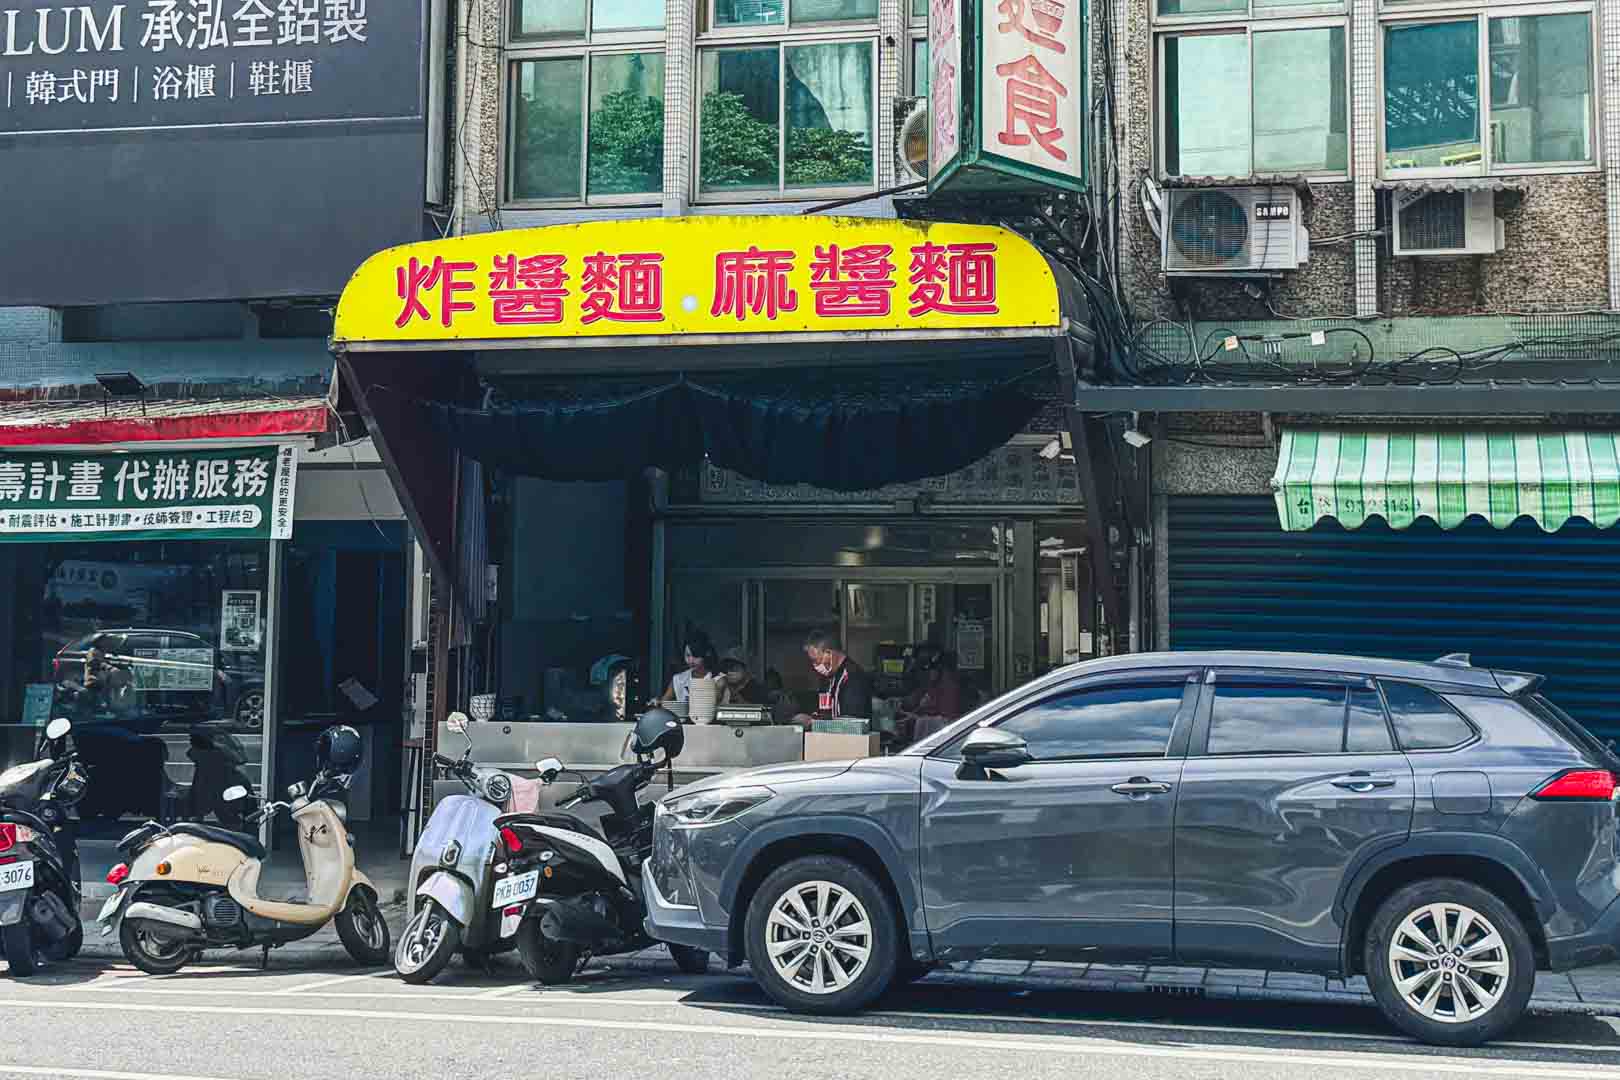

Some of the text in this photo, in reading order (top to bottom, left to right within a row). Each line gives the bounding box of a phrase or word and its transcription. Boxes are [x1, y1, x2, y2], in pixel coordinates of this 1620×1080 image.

[2, 5, 127, 56] LUM
[25, 58, 314, 105] 韓式門 浴櫃 鞋櫃
[1256, 206, 1289, 217] SAMPO
[395, 241, 999, 328] 炸醬麵 麻醬麵
[113, 456, 270, 501] 代辦服務
[8, 512, 57, 528] 耐震評估
